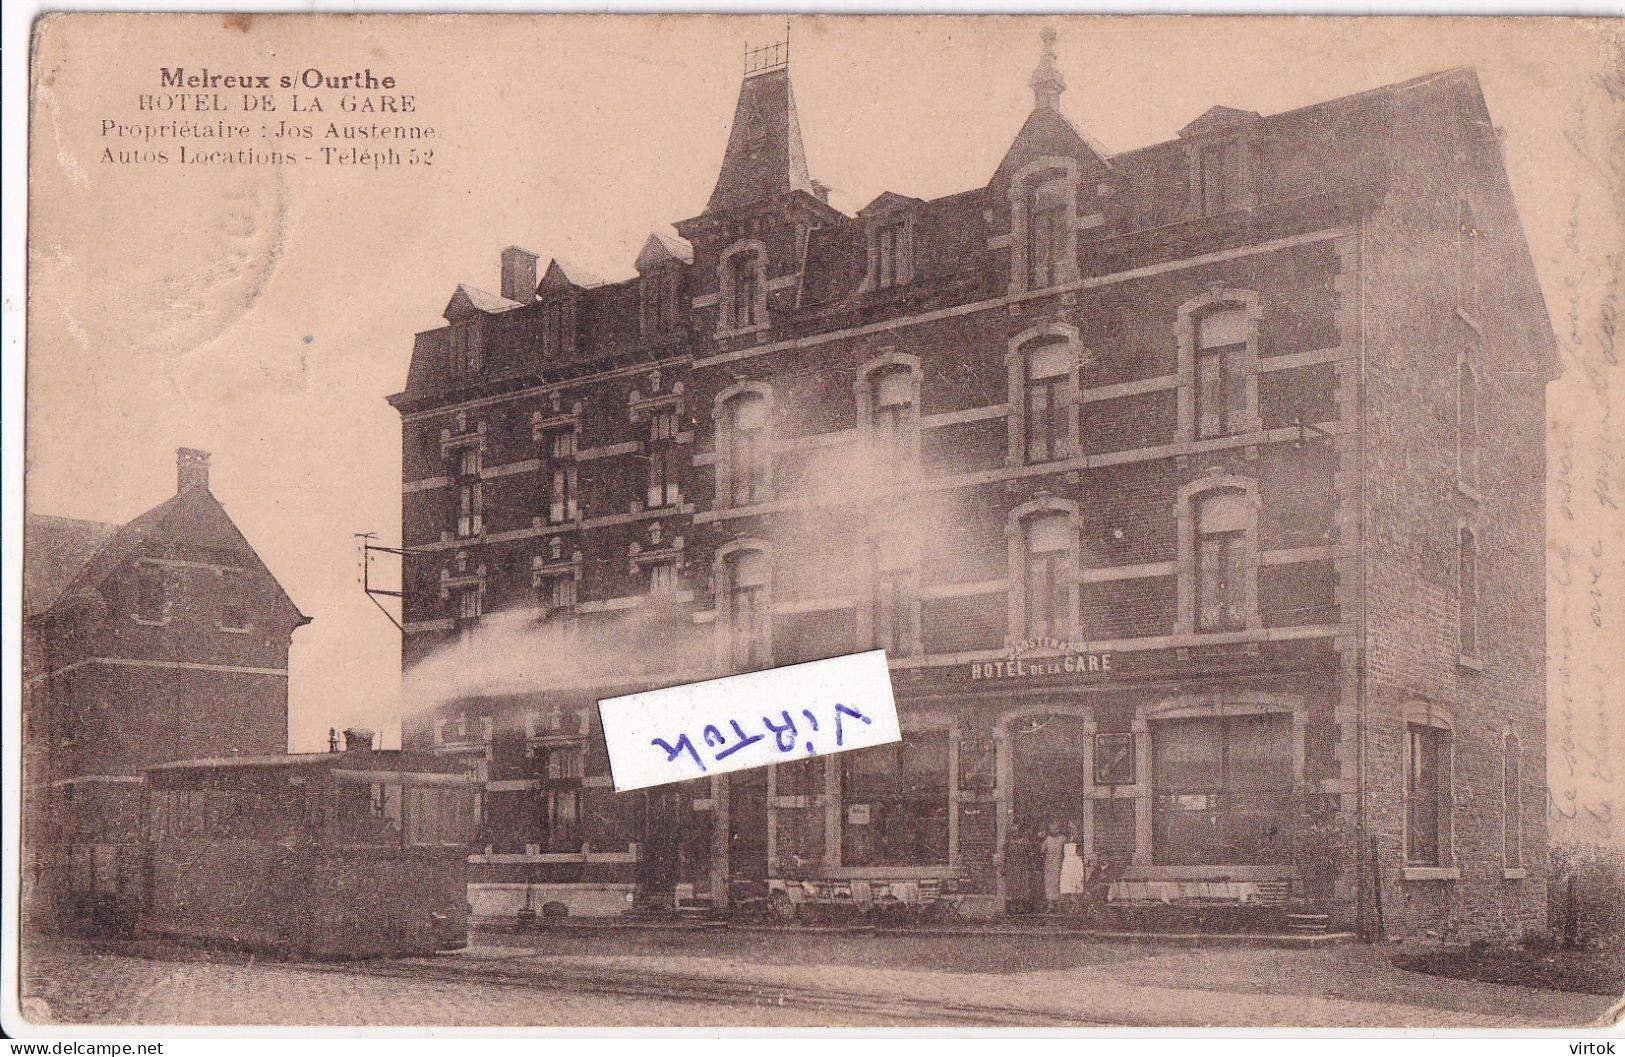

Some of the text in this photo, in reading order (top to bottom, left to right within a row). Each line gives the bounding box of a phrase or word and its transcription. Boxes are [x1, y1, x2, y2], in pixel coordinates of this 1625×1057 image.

[160, 68, 395, 89] Melreux s/Ourthe
[140, 94, 415, 113] HOTEL DE LA GARE
[102, 120, 249, 141] Propriétaire
[275, 121, 313, 138] Jos
[325, 123, 434, 139] Austenne
[101, 147, 168, 164] Autos
[180, 146, 296, 164] Locations
[410, 149, 433, 166] 52
[972, 653, 1112, 679] HOTEL DE LA GARE
